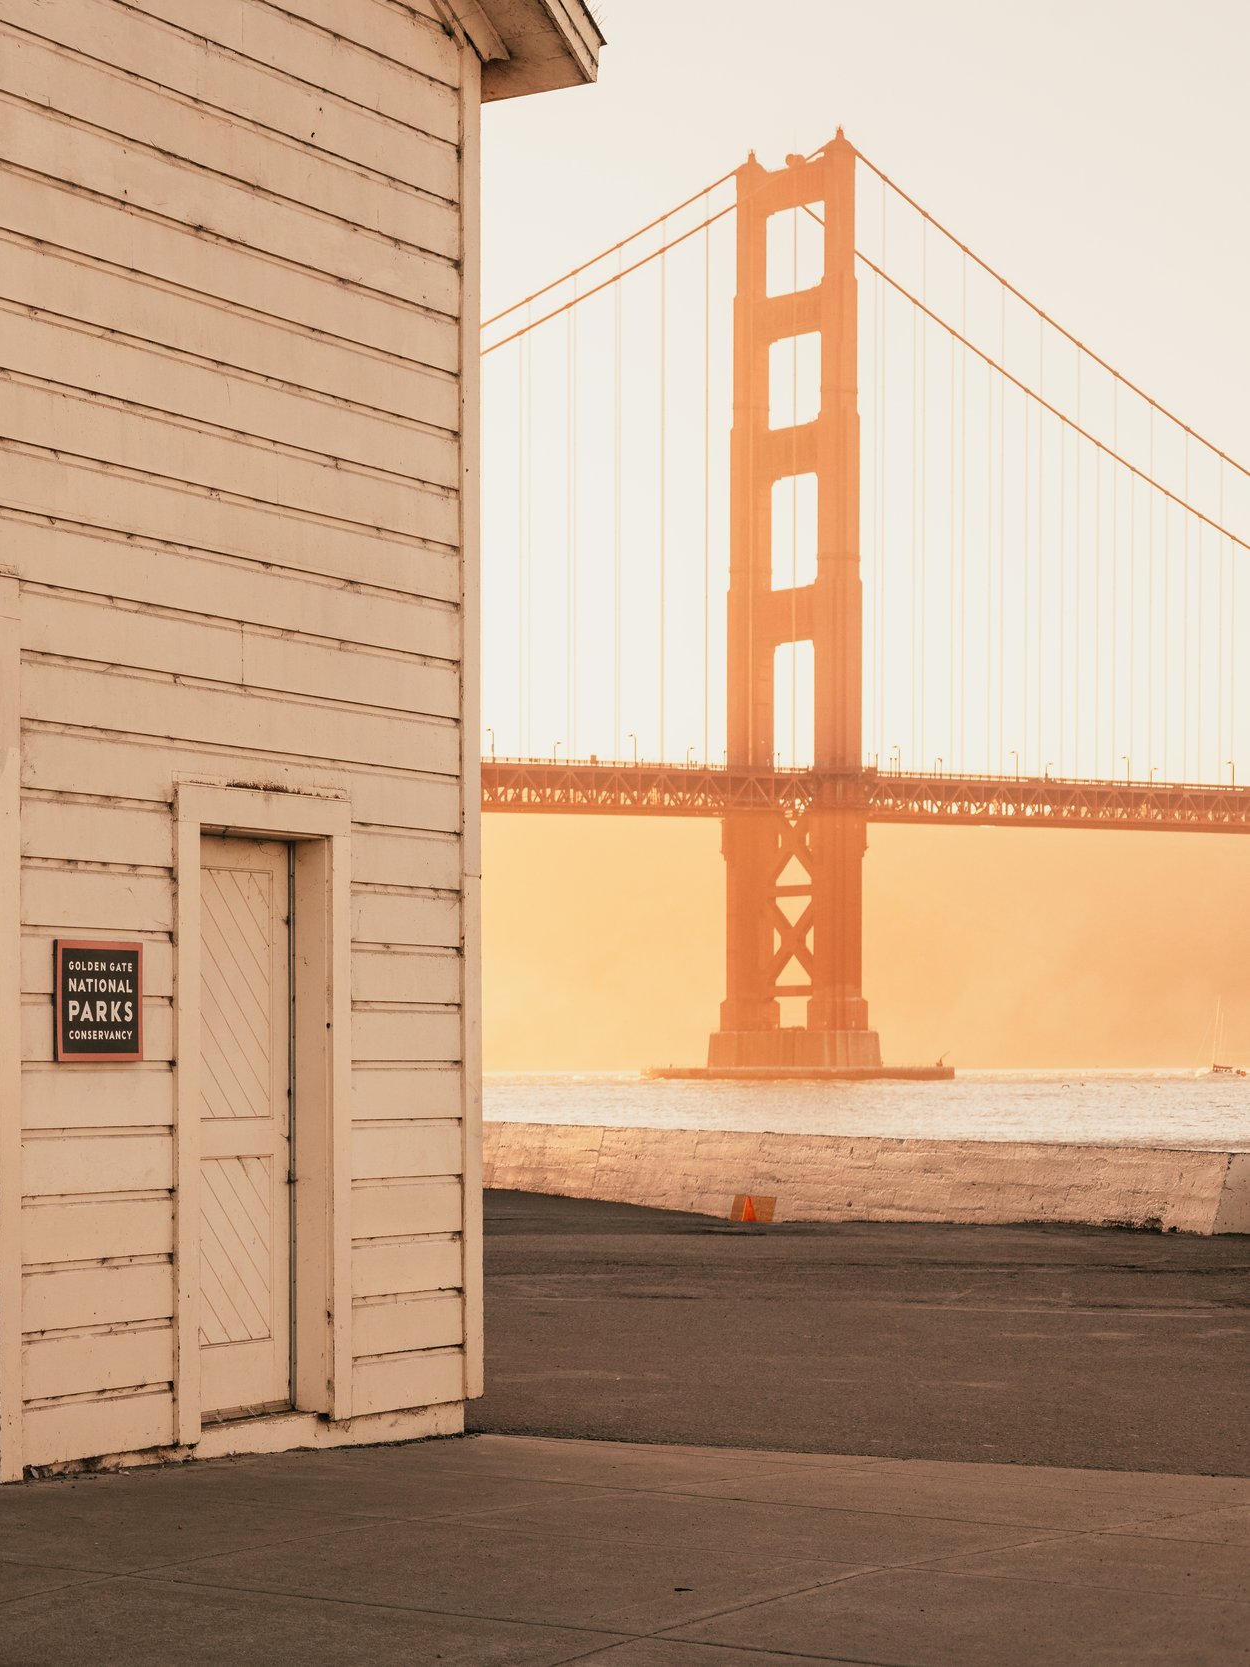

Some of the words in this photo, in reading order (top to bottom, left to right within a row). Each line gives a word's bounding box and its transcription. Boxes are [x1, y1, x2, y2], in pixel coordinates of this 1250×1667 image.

[68, 961, 106, 971] GOLDEN
[109, 962, 133, 972] GATE
[68, 978, 133, 993] NATIONAL
[68, 1000, 133, 1022] PARKS
[68, 1030, 133, 1040] CONSERVANCY
